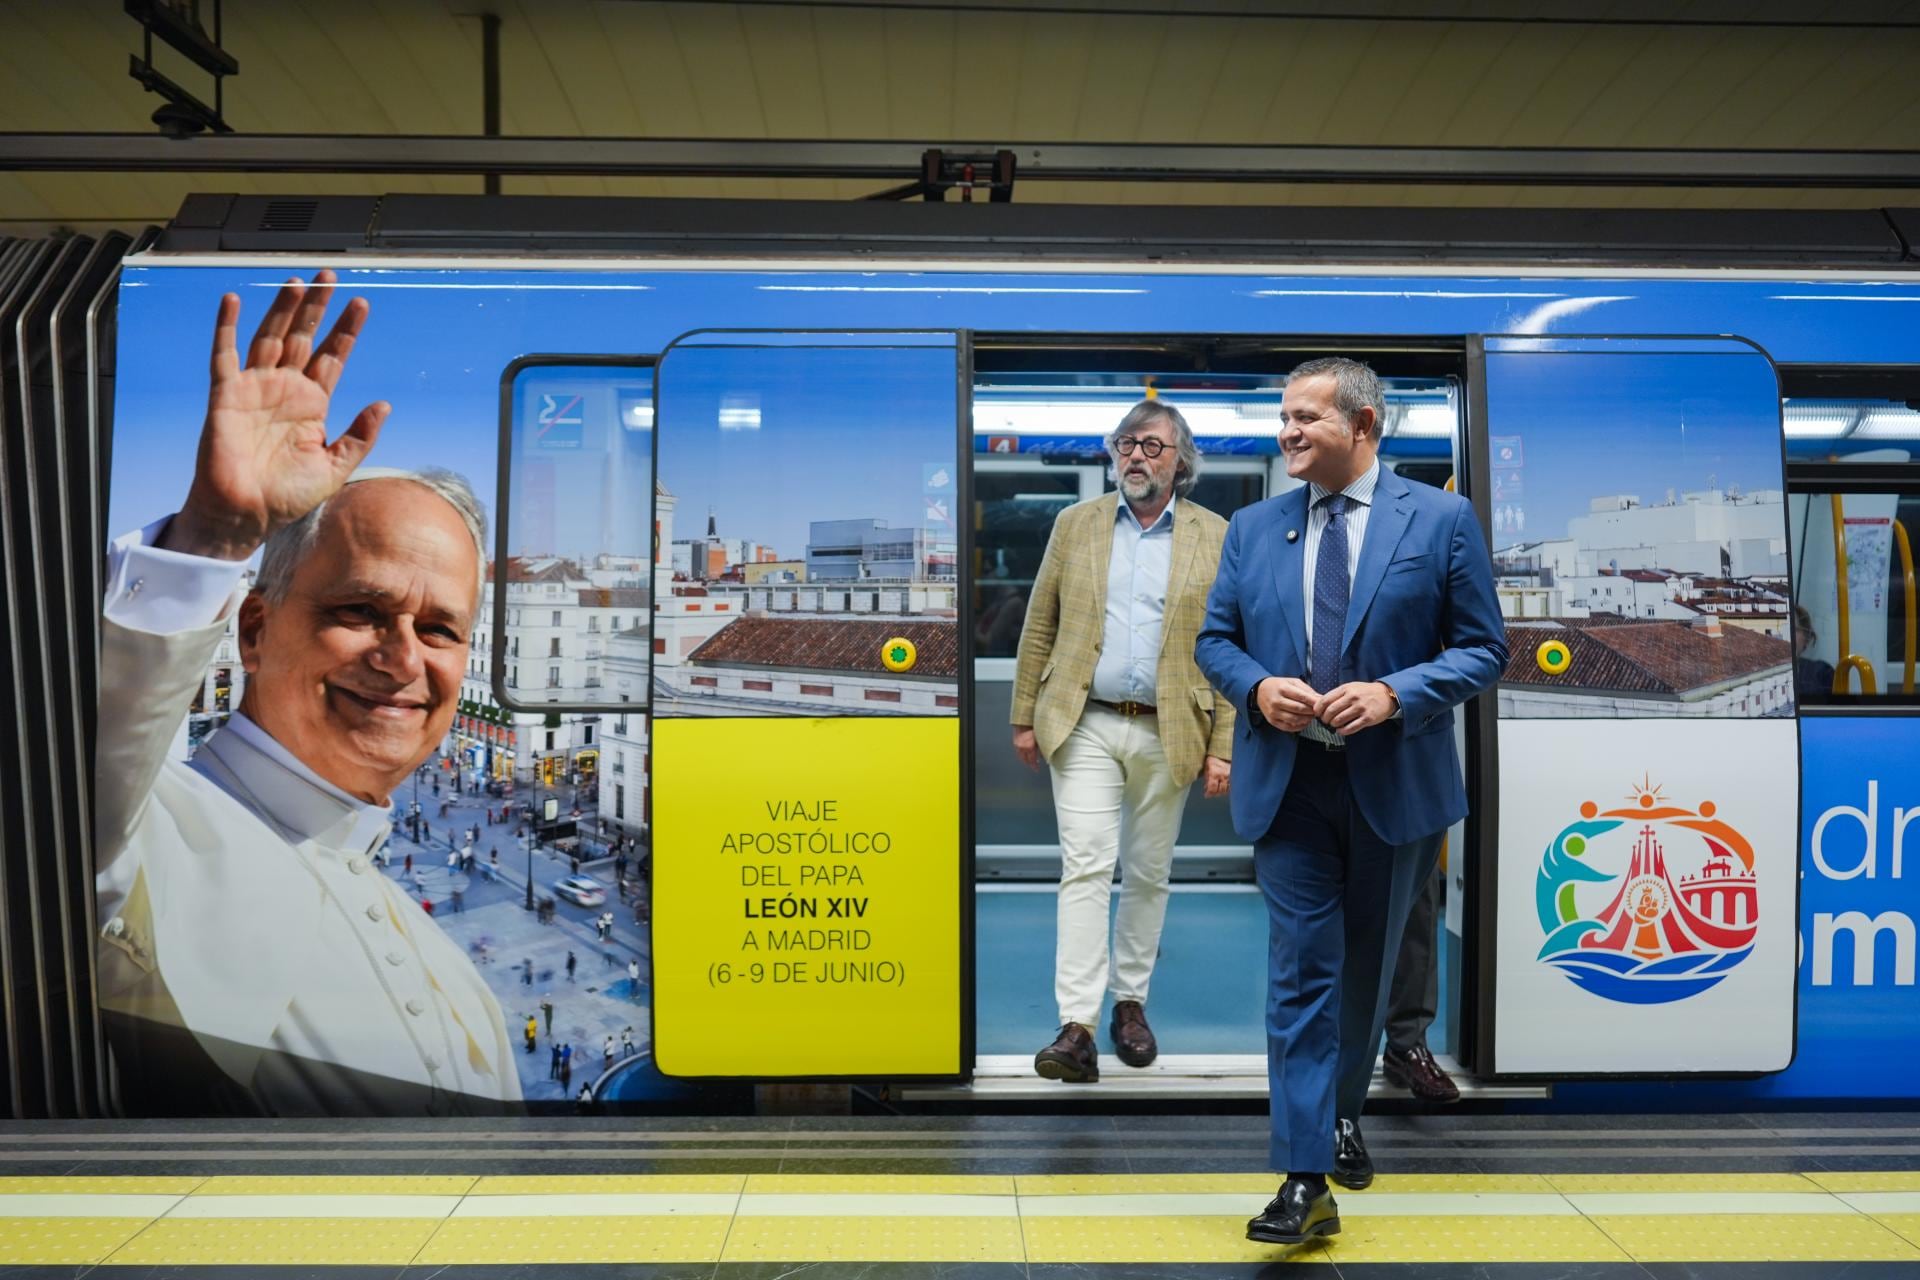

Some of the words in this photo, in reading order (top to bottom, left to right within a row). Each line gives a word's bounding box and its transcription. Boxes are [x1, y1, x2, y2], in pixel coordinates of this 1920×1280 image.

[766, 799, 838, 822] VIAJE
[720, 828, 892, 855] APOSTÓLICO
[741, 865, 792, 887] DEL
[800, 865, 865, 887] PAPA
[744, 892, 818, 920] LEÓN
[826, 897, 870, 919] XIV
[741, 929, 760, 952] A
[768, 929, 872, 952] MADRID
[773, 962, 809, 984] DE
[815, 961, 906, 988] JUNIO)
